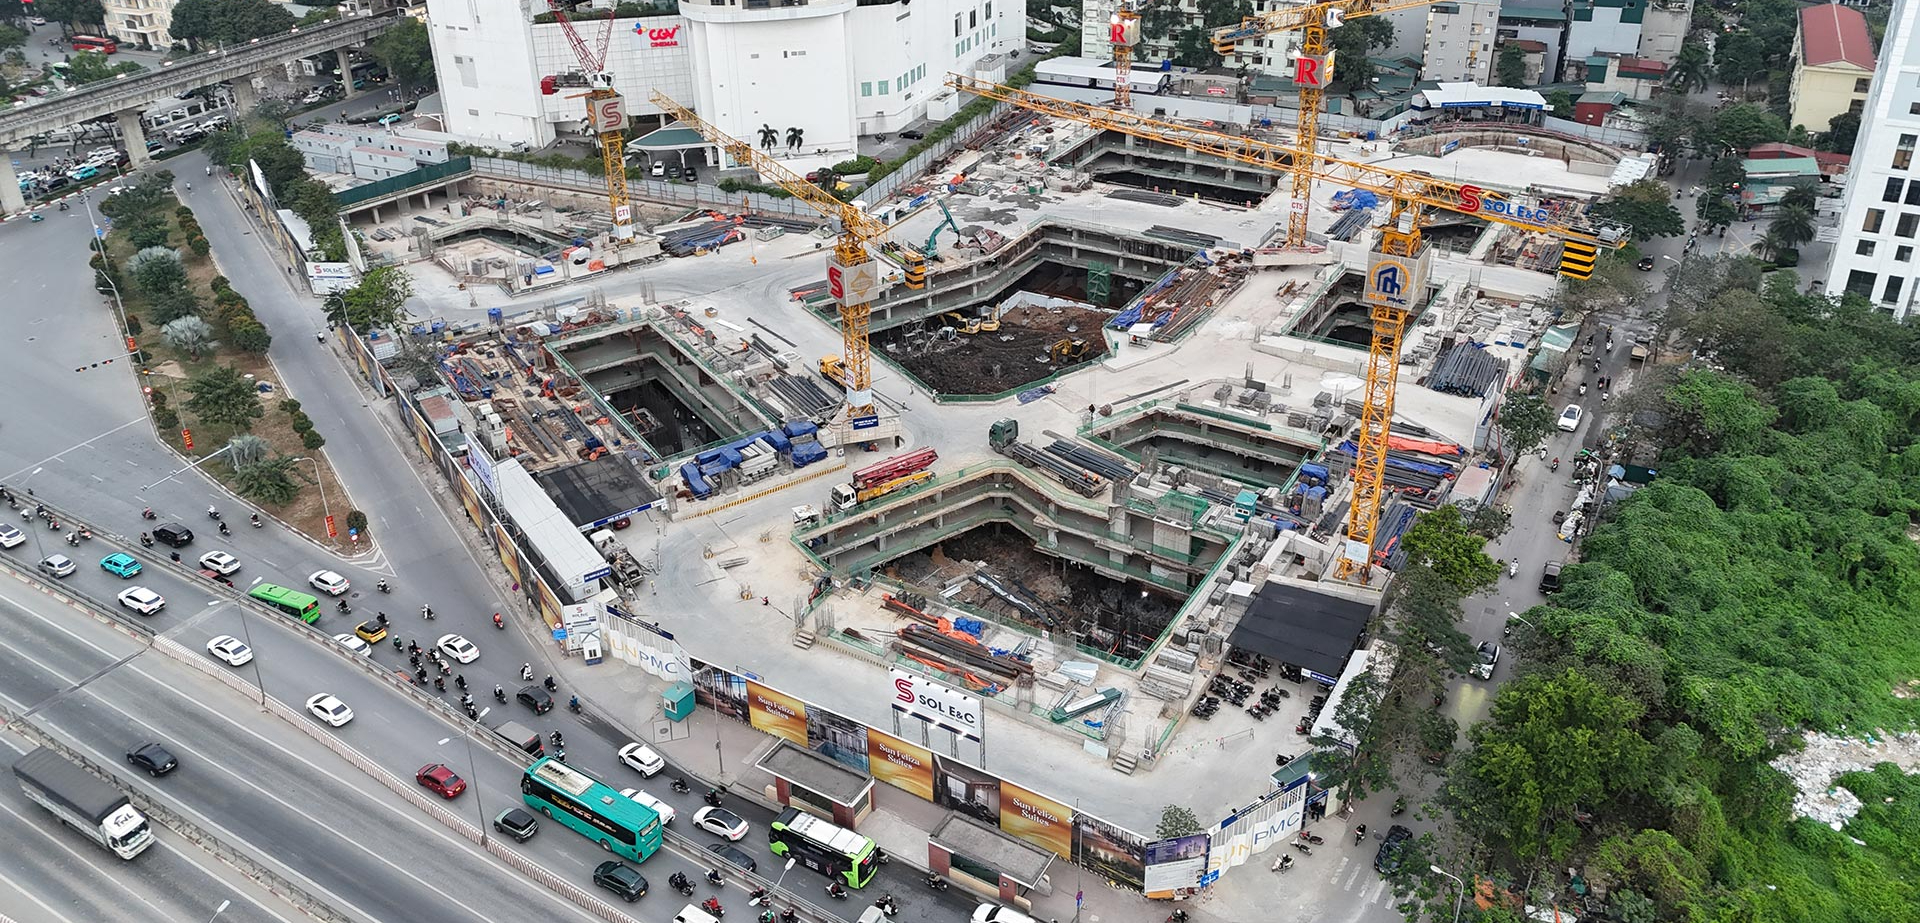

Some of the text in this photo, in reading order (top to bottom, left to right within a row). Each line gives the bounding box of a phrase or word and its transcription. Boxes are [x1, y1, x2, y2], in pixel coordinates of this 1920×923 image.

[649, 27, 678, 41] CGV
[617, 208, 629, 218] CT1
[1483, 199, 1513, 215] SOL
[1516, 205, 1548, 221] E&C
[757, 695, 796, 716] Sun Feliza
[765, 706, 789, 720] Suites
[919, 694, 945, 713] SOL
[949, 705, 975, 724] E&C
[879, 743, 921, 766] Sun Feliza
[887, 754, 913, 770] Suites
[1012, 797, 1059, 823] Sun Feliza
[1021, 809, 1050, 827] Suites
